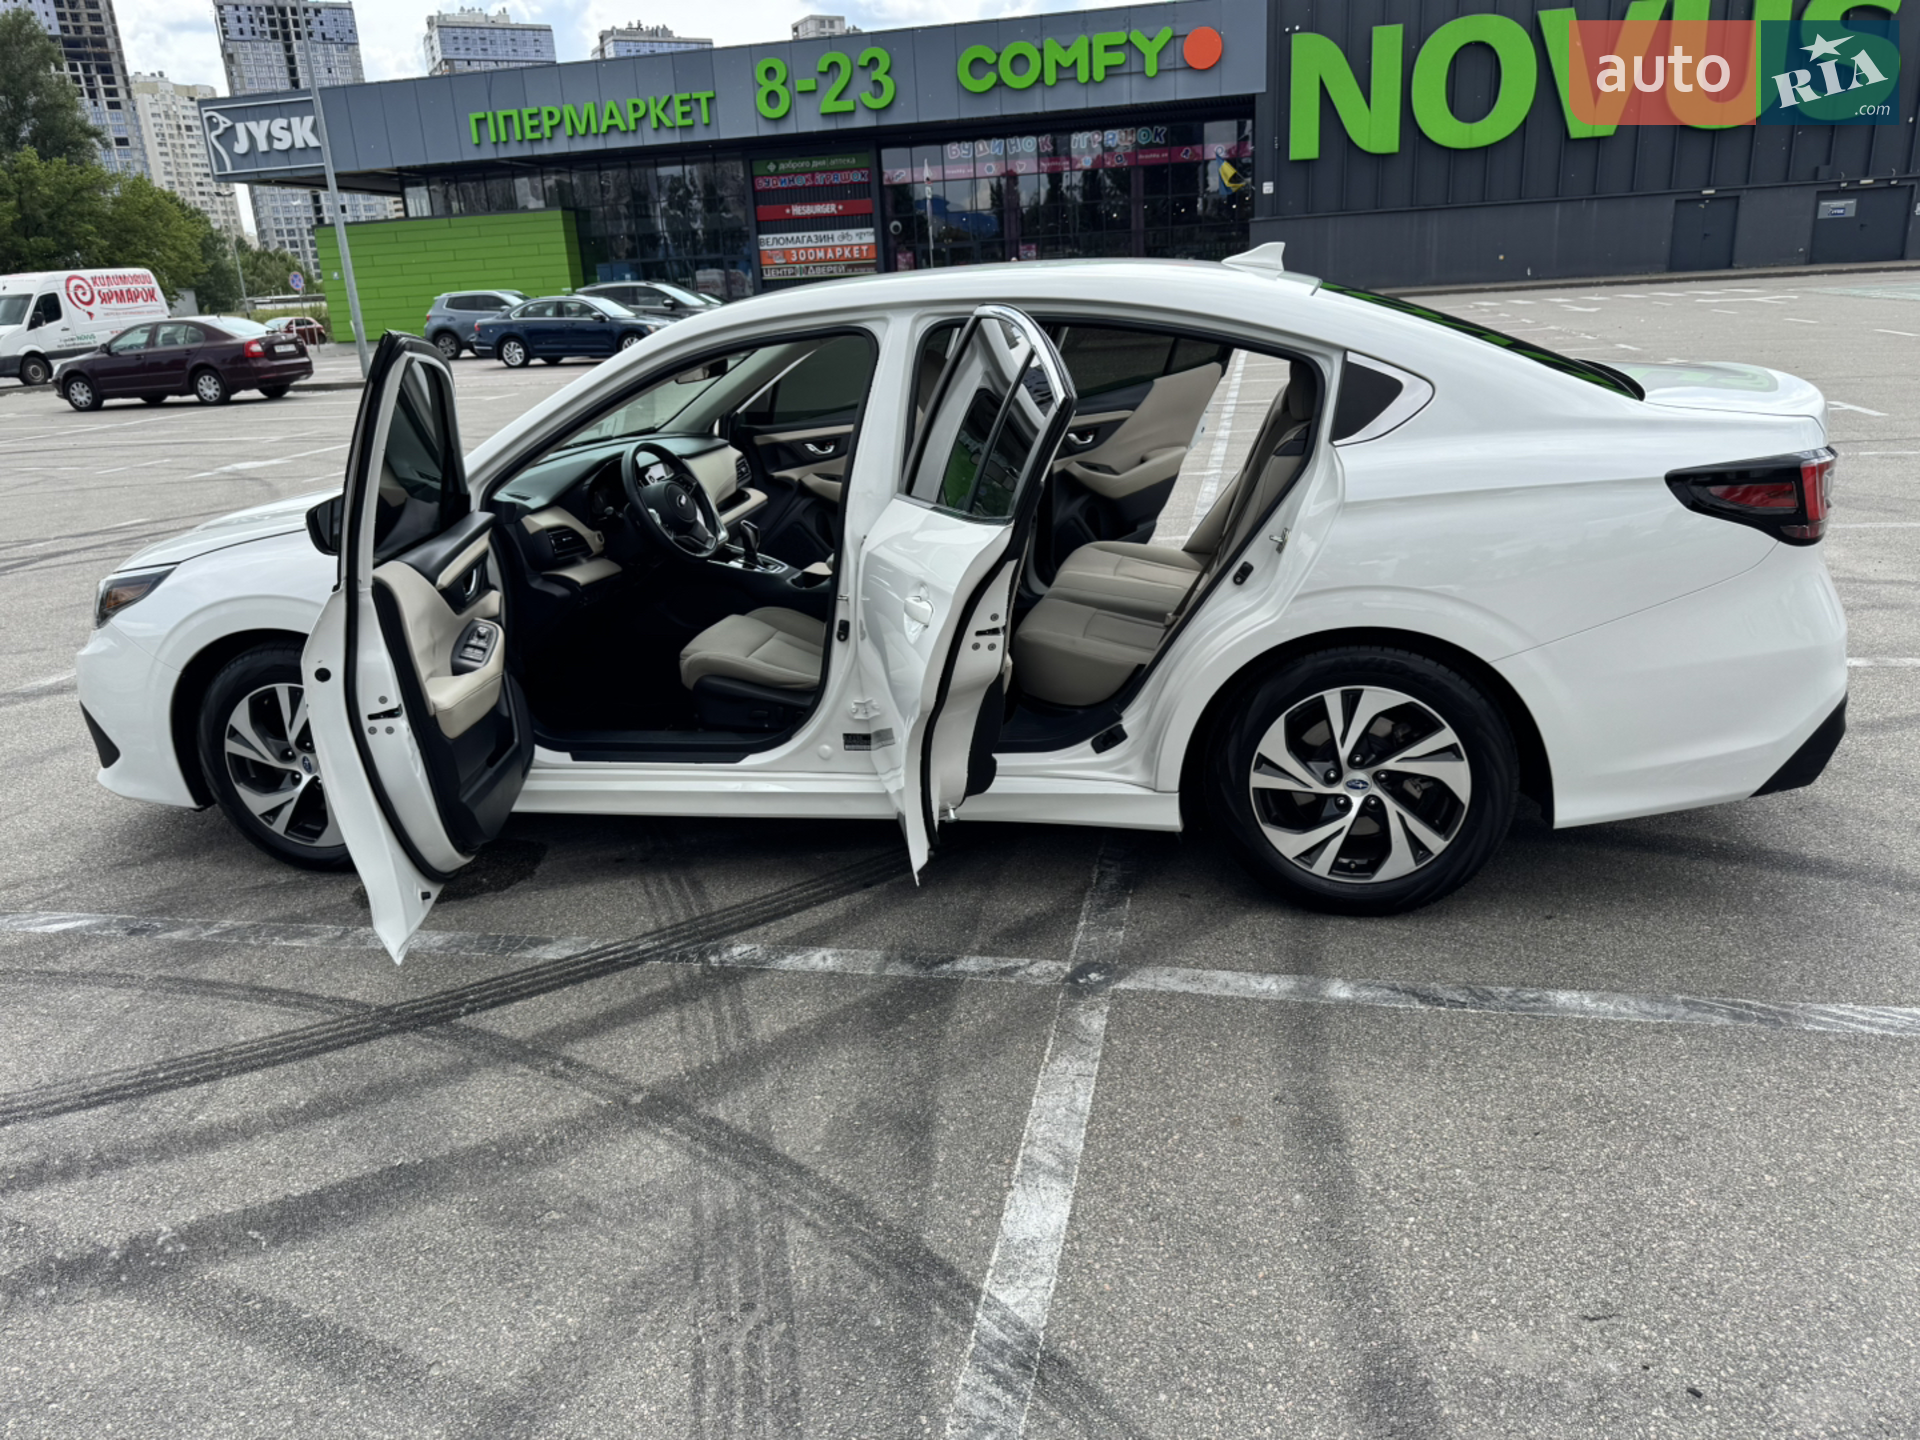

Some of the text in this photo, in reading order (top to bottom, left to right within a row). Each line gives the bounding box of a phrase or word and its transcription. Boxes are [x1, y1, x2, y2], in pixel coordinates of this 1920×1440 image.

[957, 26, 1173, 93] COMFY
[1289, 0, 1900, 160] NOVUS
[468, 46, 896, 145] ГІПЕРМАРКЕТ 8-23
[233, 115, 321, 155] JYSK
[947, 134, 1053, 160] БУДИНОК
[779, 157, 856, 171] доброго дня аптека
[756, 173, 813, 189] БУДИНОК
[791, 203, 838, 216] HESBURGER
[760, 233, 835, 248] ВЕЛОМАГАЗИН
[791, 245, 869, 261] ЗООМАРКЕТ
[763, 264, 846, 277] ЦЕНТР ДВЕРЕЙ
[97, 287, 157, 304] ЯРМАРОК
